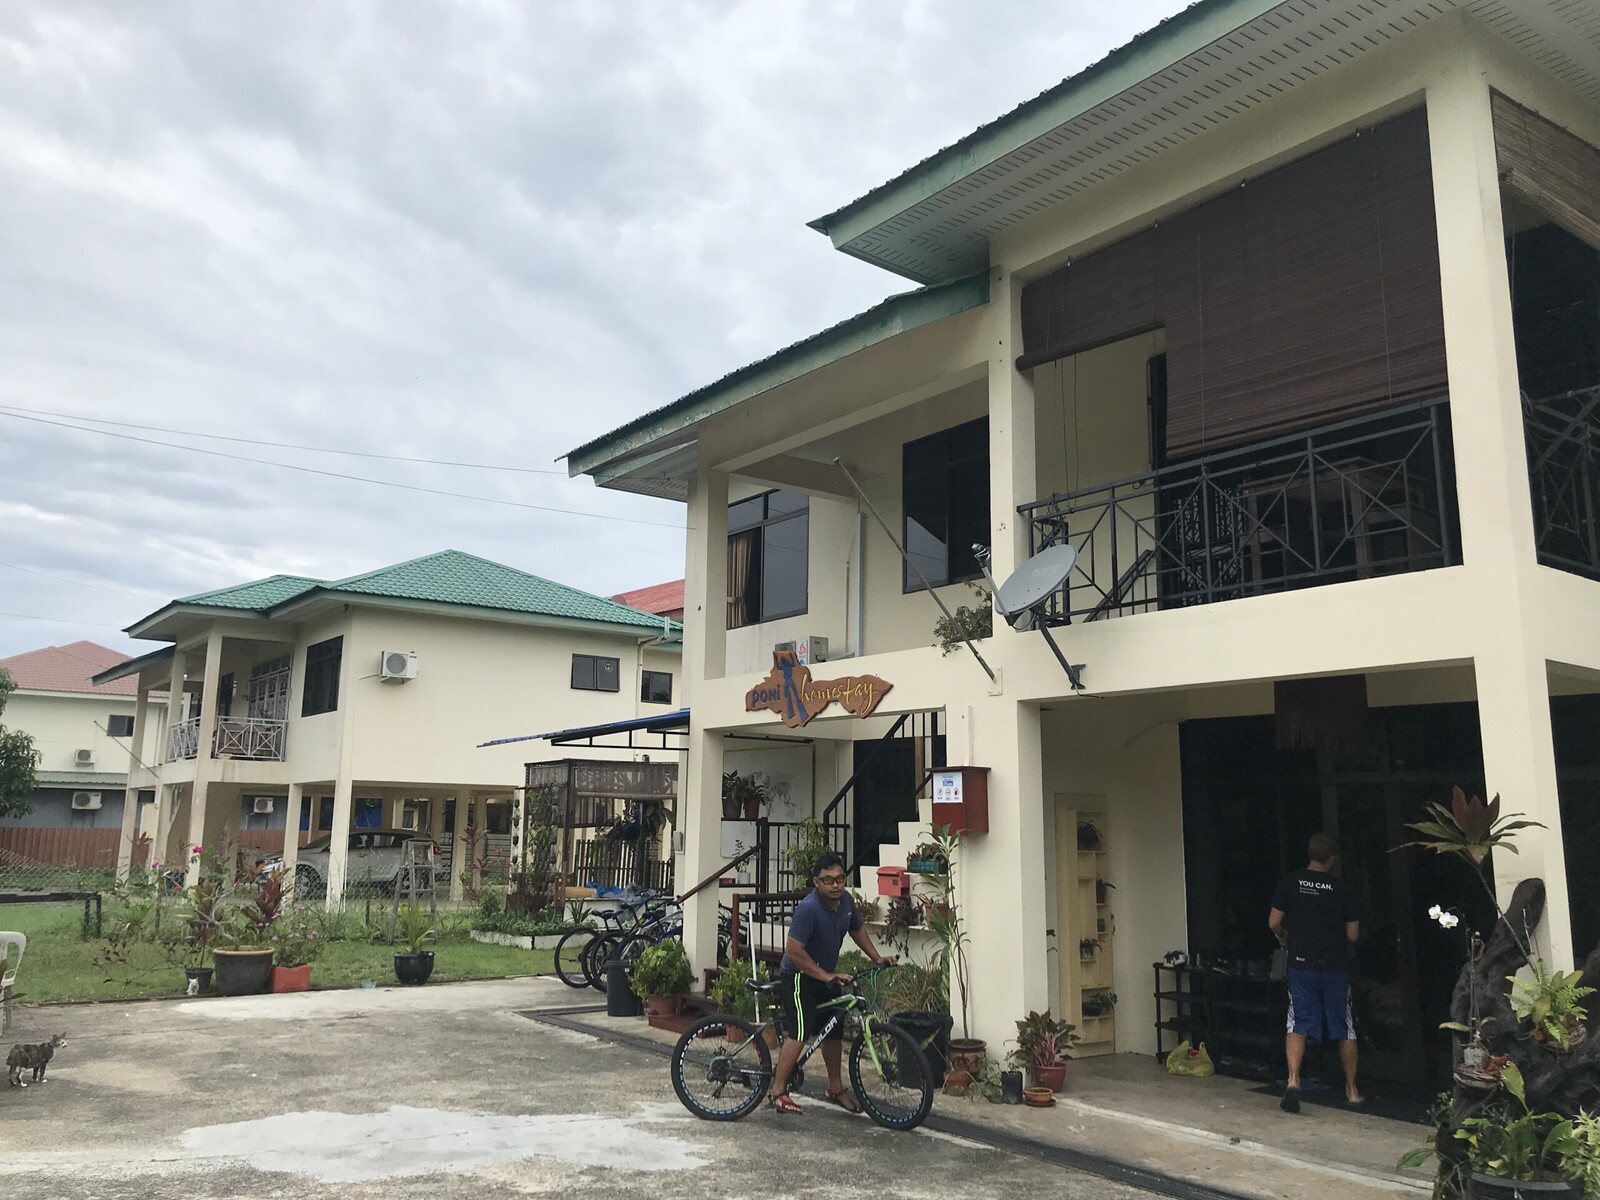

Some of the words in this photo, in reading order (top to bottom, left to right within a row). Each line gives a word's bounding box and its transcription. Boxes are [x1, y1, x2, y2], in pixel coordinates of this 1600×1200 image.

[801, 674, 878, 715] homestay
[1298, 879, 1314, 888] YOU
[1315, 882, 1334, 891] CAN.
